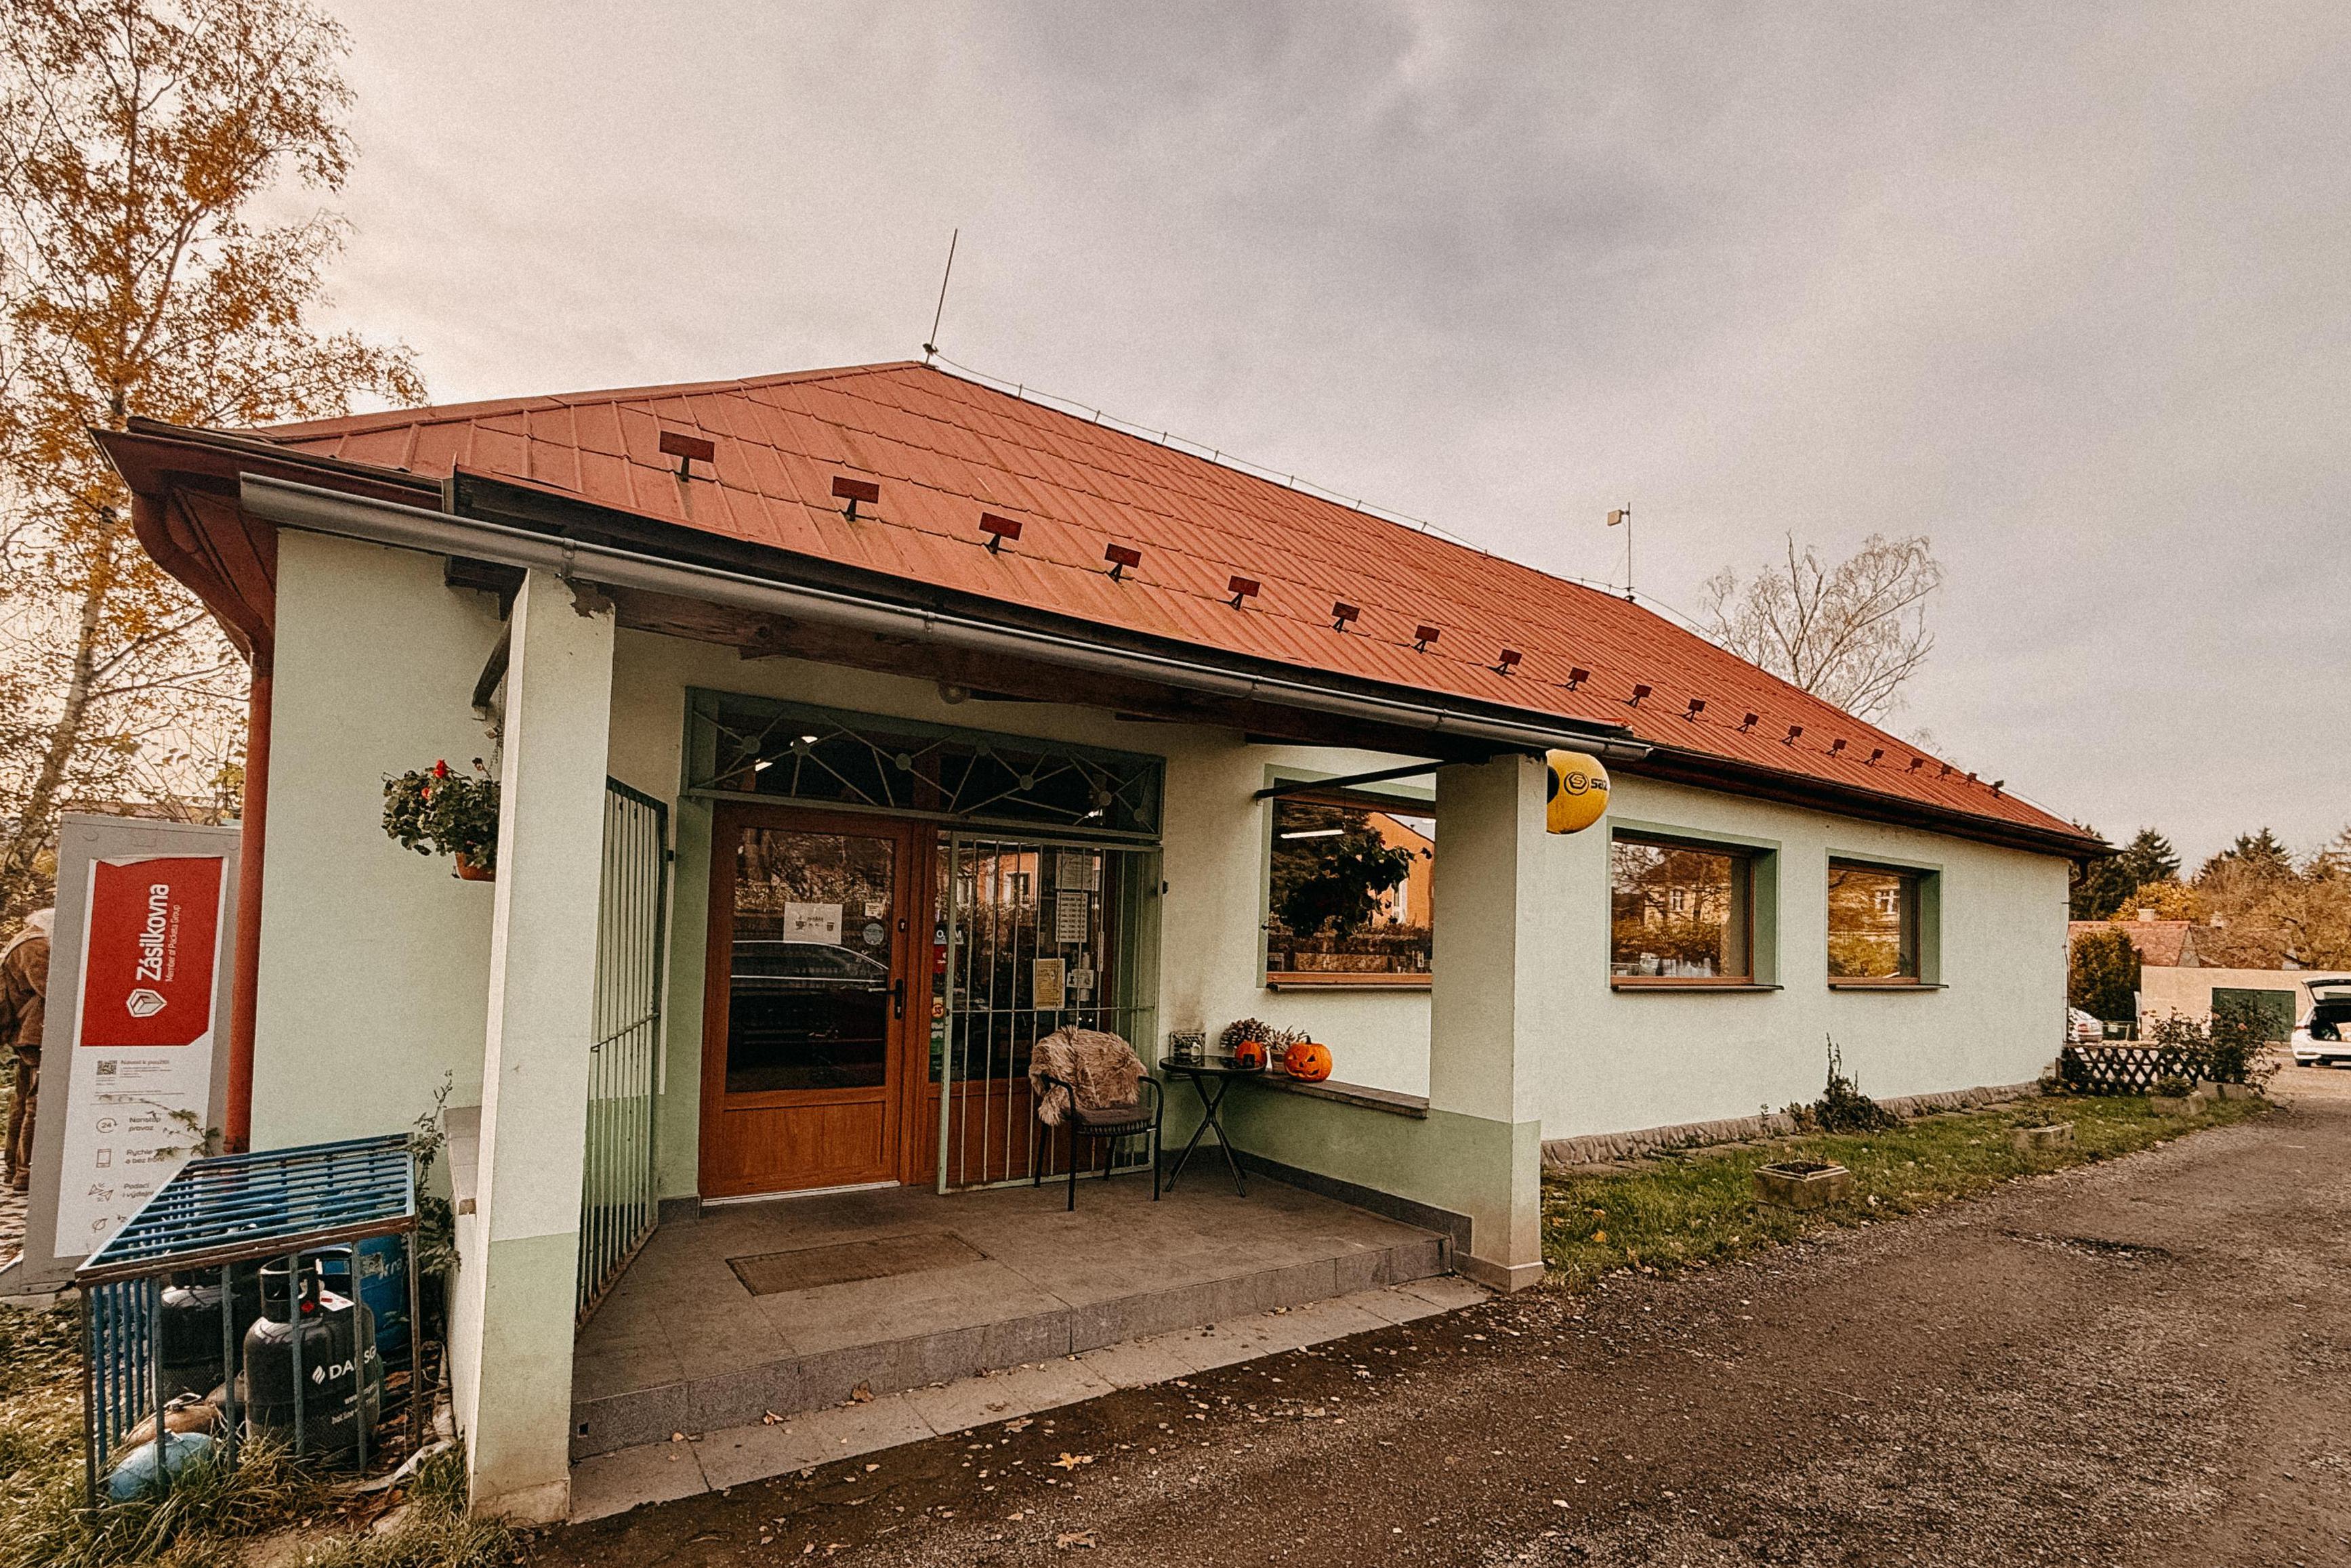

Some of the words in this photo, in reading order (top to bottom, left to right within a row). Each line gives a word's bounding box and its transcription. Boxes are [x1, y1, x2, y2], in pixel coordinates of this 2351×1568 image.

[136, 884, 169, 981] Zásilkovna
[165, 958, 175, 982] Member
[171, 904, 182, 923] Group
